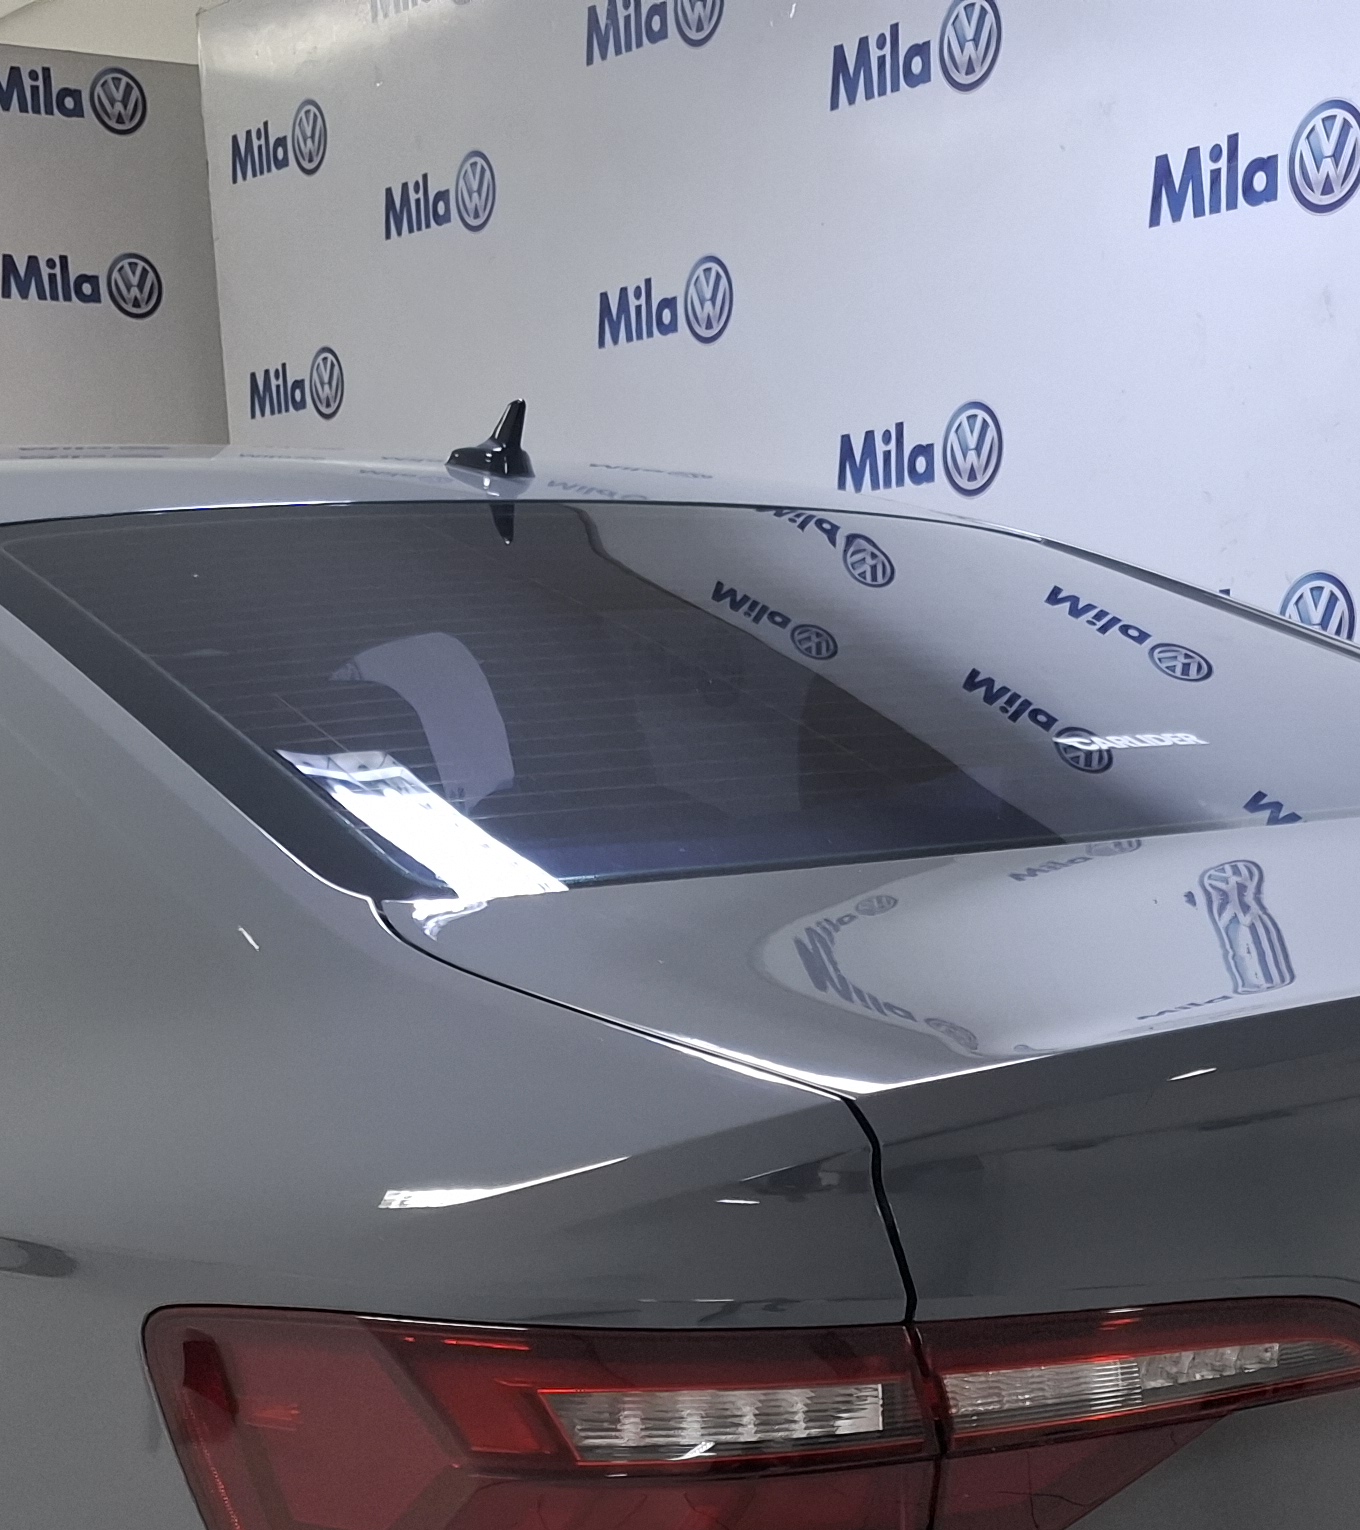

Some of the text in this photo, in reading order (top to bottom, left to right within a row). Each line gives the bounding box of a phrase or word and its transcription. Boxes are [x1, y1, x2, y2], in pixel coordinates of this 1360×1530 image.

[586, 0, 668, 66] Mila
[830, 22, 931, 111] Mila
[232, 121, 289, 184] Mila
[1149, 133, 1278, 228] Mila
[385, 173, 451, 240] Mila
[2, 254, 101, 303] Mila
[598, 278, 678, 349] Mila
[250, 363, 306, 419] Mila
[838, 422, 934, 493] Mila
[1053, 733, 1210, 750] CARLIDER
